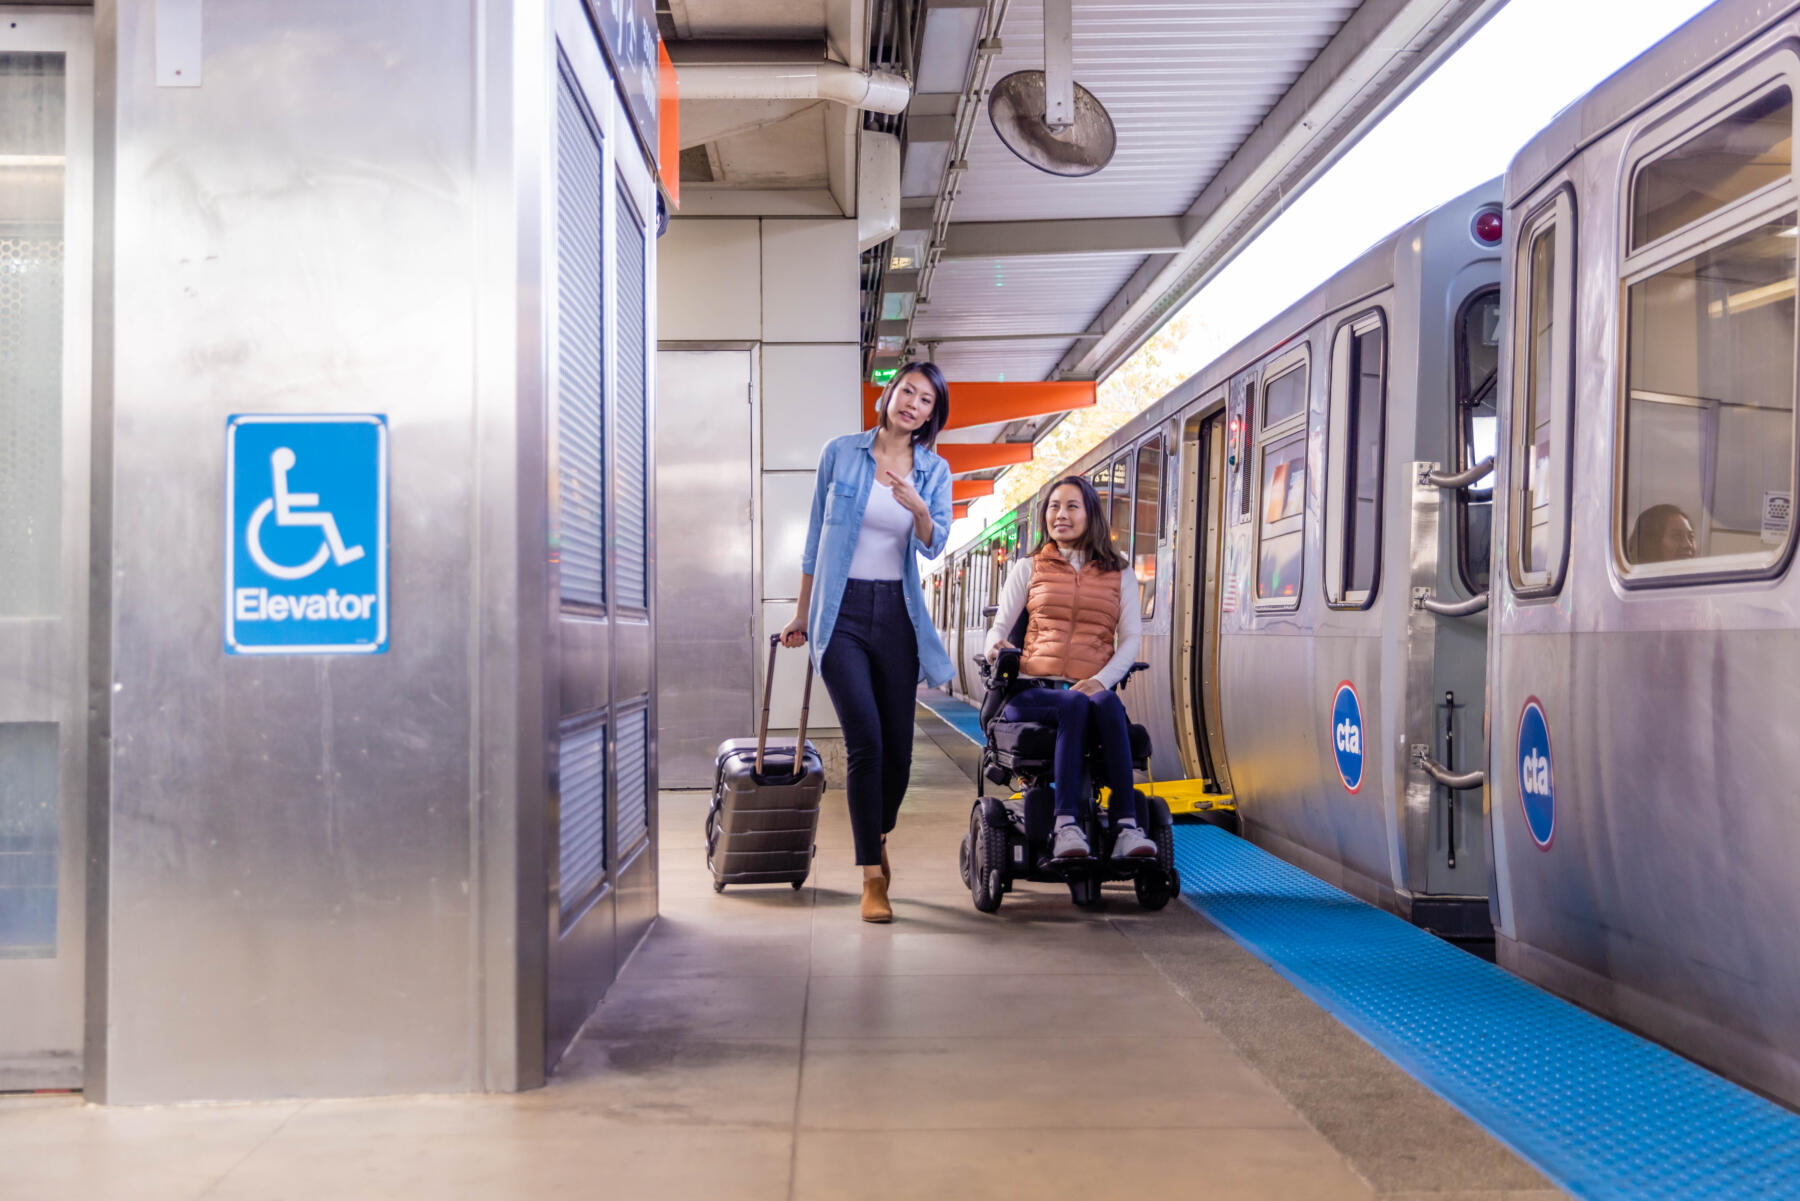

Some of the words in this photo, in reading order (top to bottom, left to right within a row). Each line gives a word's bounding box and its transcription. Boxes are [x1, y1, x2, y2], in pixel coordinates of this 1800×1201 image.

[236, 587, 376, 621] Elevator
[1336, 717, 1359, 754] cta
[1523, 747, 1548, 796] cta
